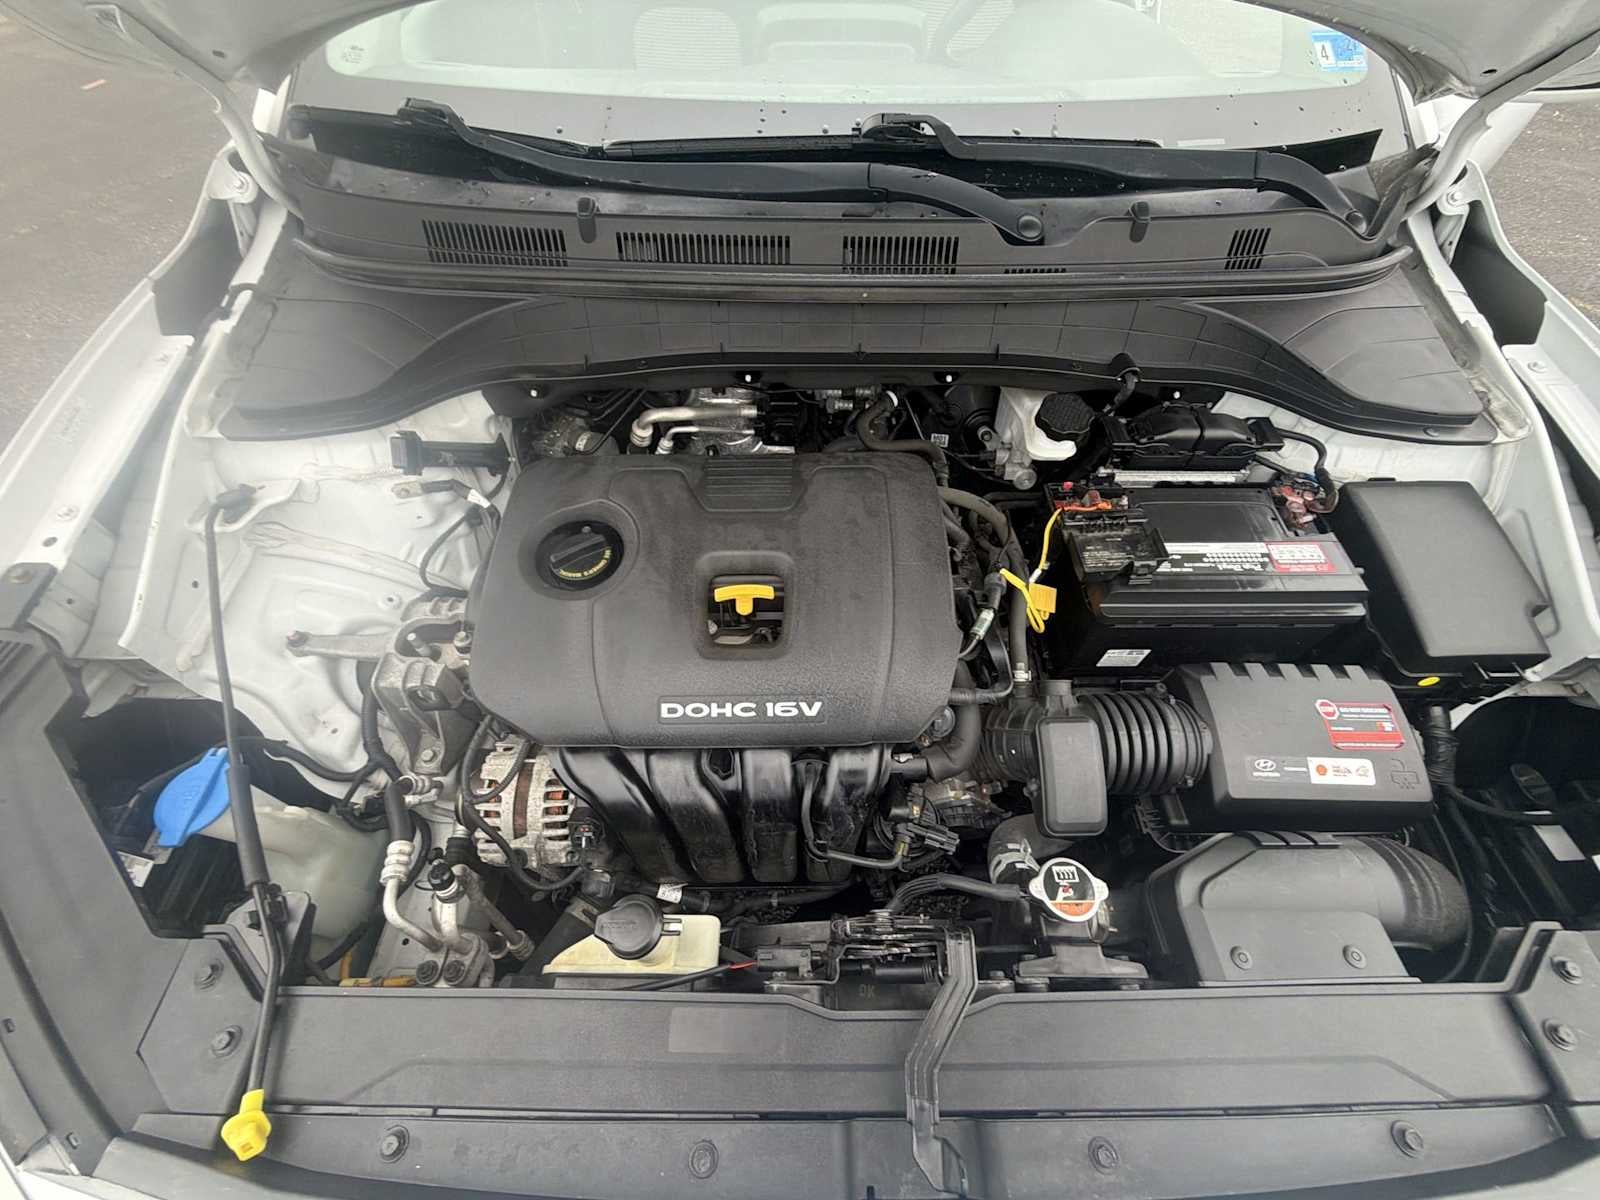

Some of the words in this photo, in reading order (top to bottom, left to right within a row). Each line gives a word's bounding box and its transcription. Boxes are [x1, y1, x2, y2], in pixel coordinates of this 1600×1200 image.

[1320, 44, 1328, 60] 4
[660, 702, 757, 718] DOHC
[765, 701, 823, 717] 16V
